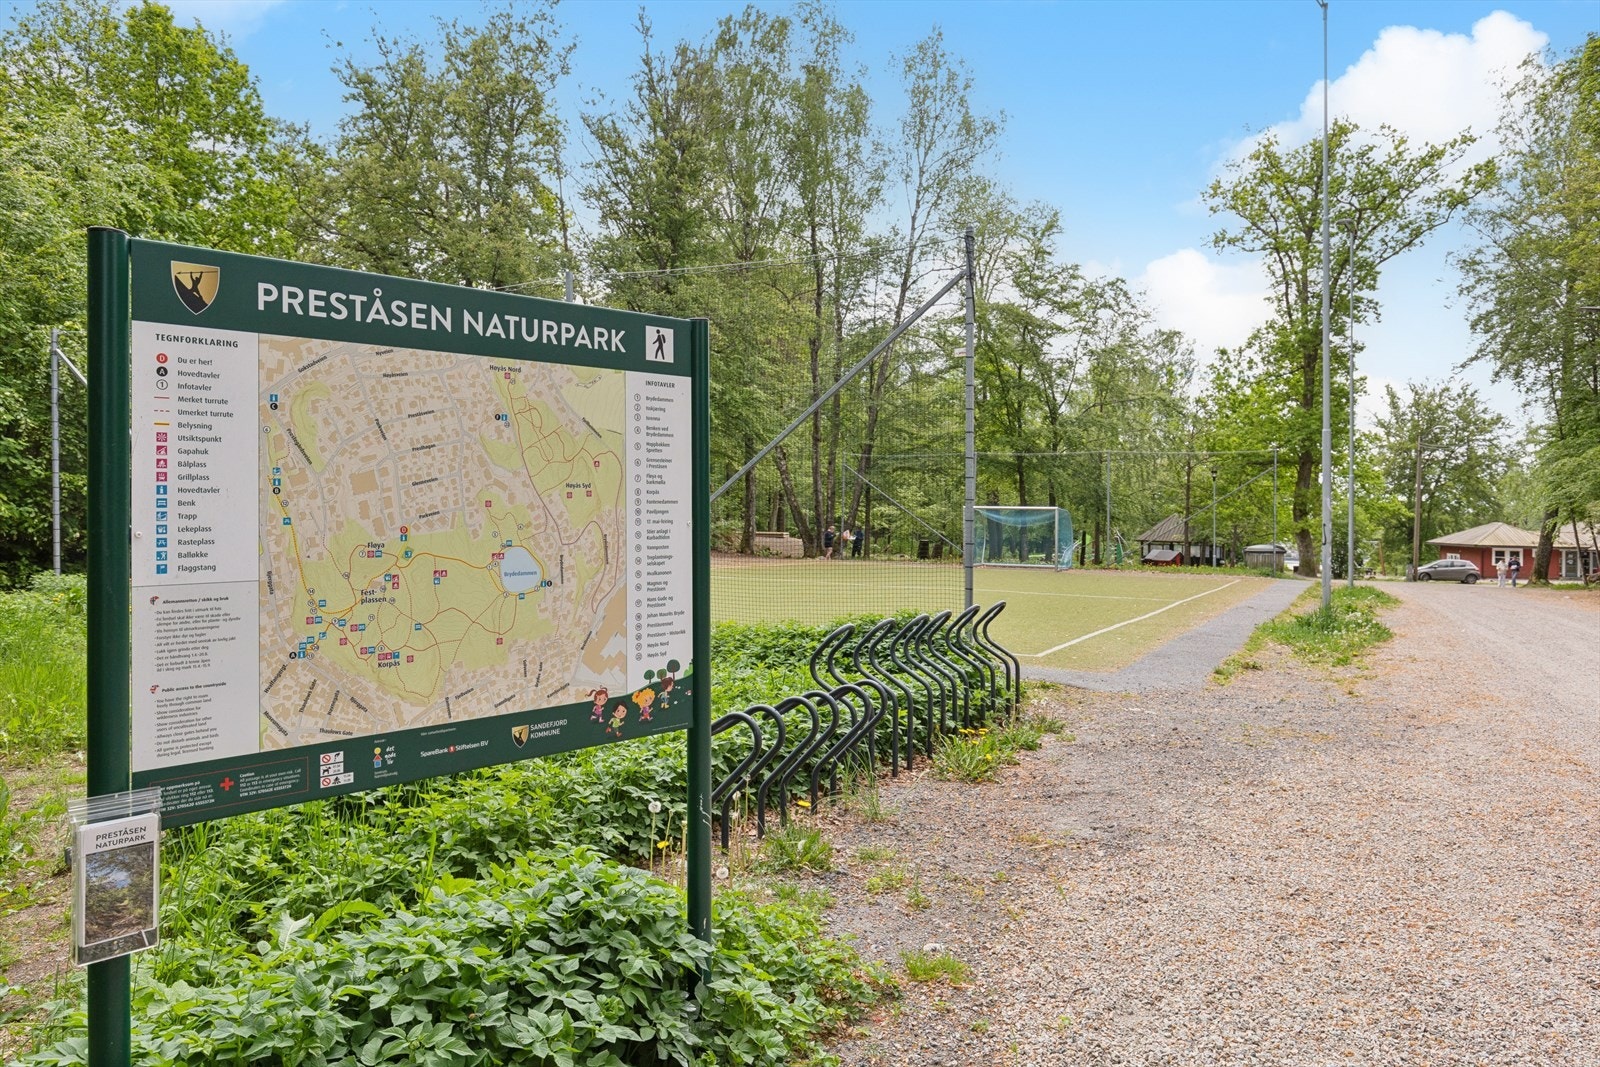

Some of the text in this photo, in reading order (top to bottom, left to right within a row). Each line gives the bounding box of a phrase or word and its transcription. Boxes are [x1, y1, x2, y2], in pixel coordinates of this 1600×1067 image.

[257, 282, 626, 354] PRESTÅSEN NATURPARK
[156, 334, 239, 348] TEGNFORKLARING
[490, 364, 506, 372] Høyås
[178, 370, 220, 379] Hovedtavler
[178, 422, 212, 431] Belysning
[178, 435, 222, 443] Utsiktspunkt
[178, 461, 207, 469] Bålplass
[178, 564, 216, 572] Flaggstang
[530, 719, 568, 731] SANDEFJORD
[530, 728, 560, 739] KOMMUNE
[420, 748, 448, 758] SpareBank
[456, 742, 480, 752] Stiftelsen
[96, 826, 146, 841] PRESTÅSEN
[96, 834, 146, 849] NATURPARK
